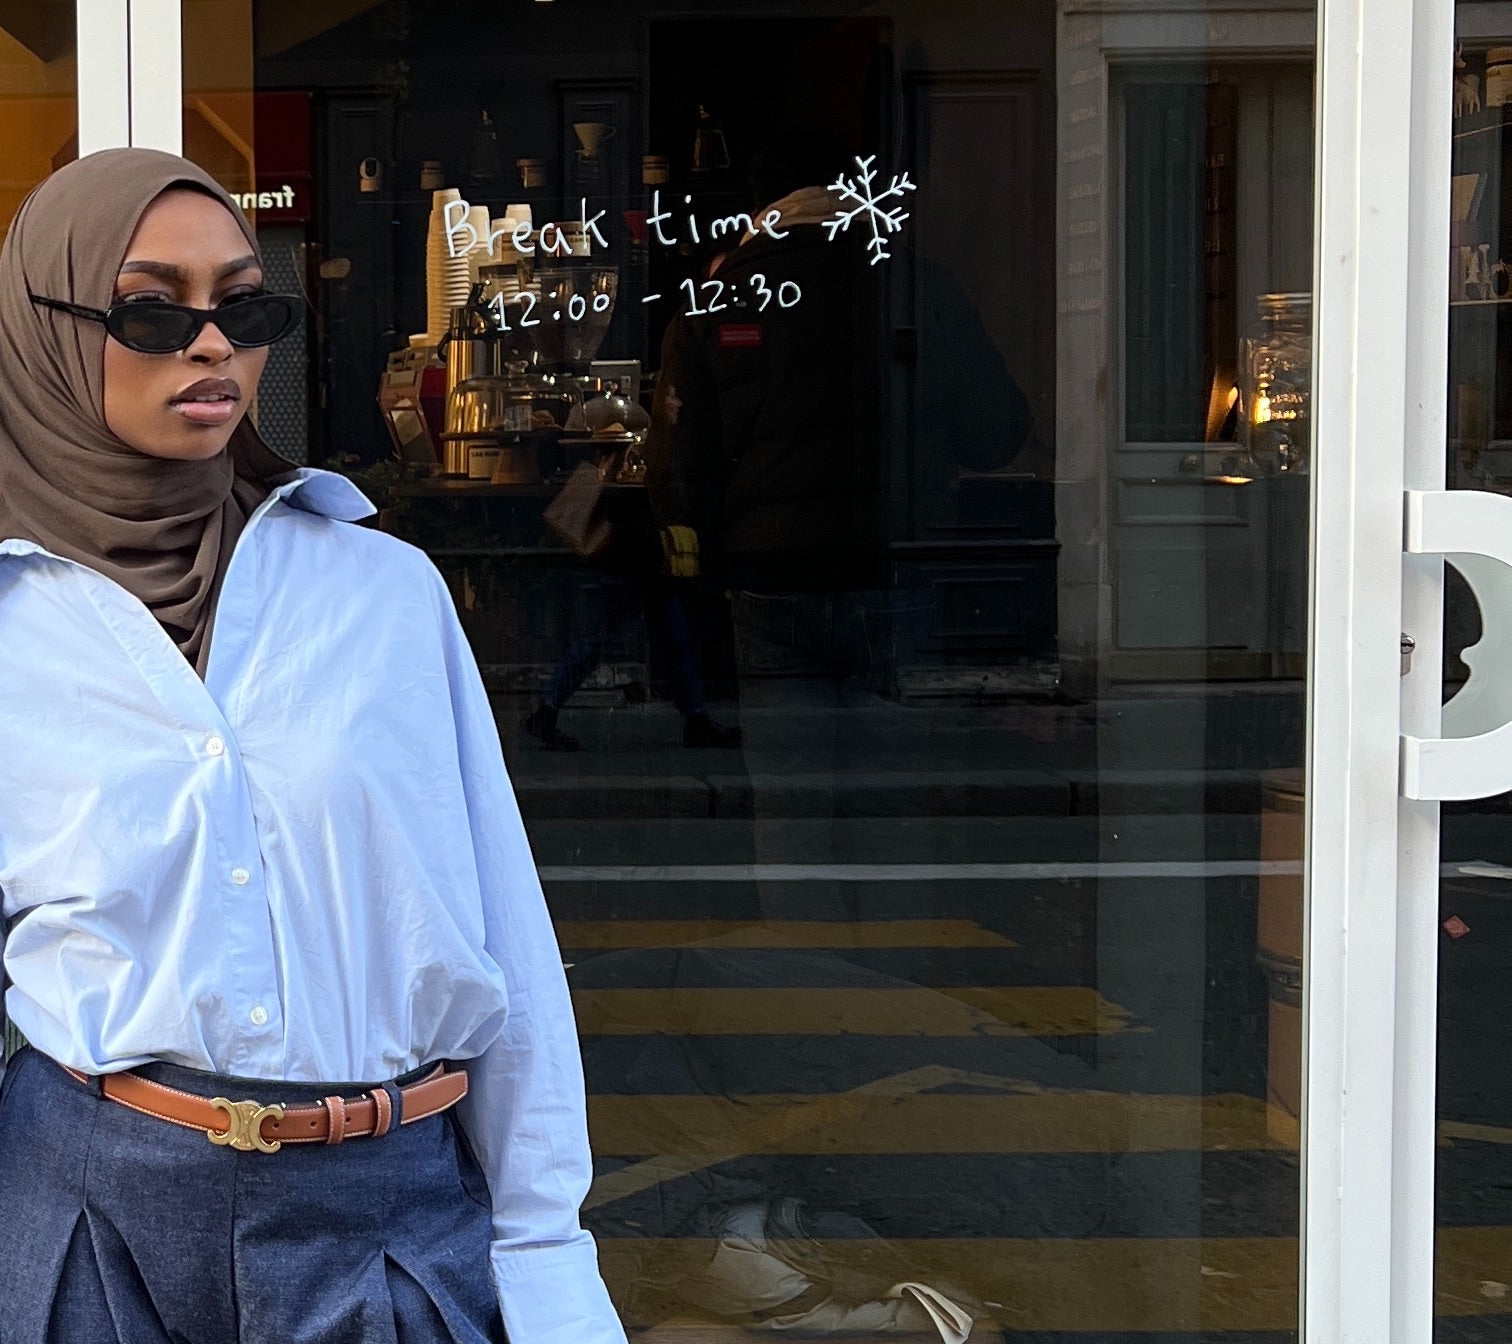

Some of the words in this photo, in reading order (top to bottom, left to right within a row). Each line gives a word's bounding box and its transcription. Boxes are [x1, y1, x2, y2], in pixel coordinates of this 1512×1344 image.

[443, 197, 609, 258] Break
[646, 190, 790, 245] time
[488, 291, 610, 332] 12:00
[679, 273, 802, 316] 12:30
